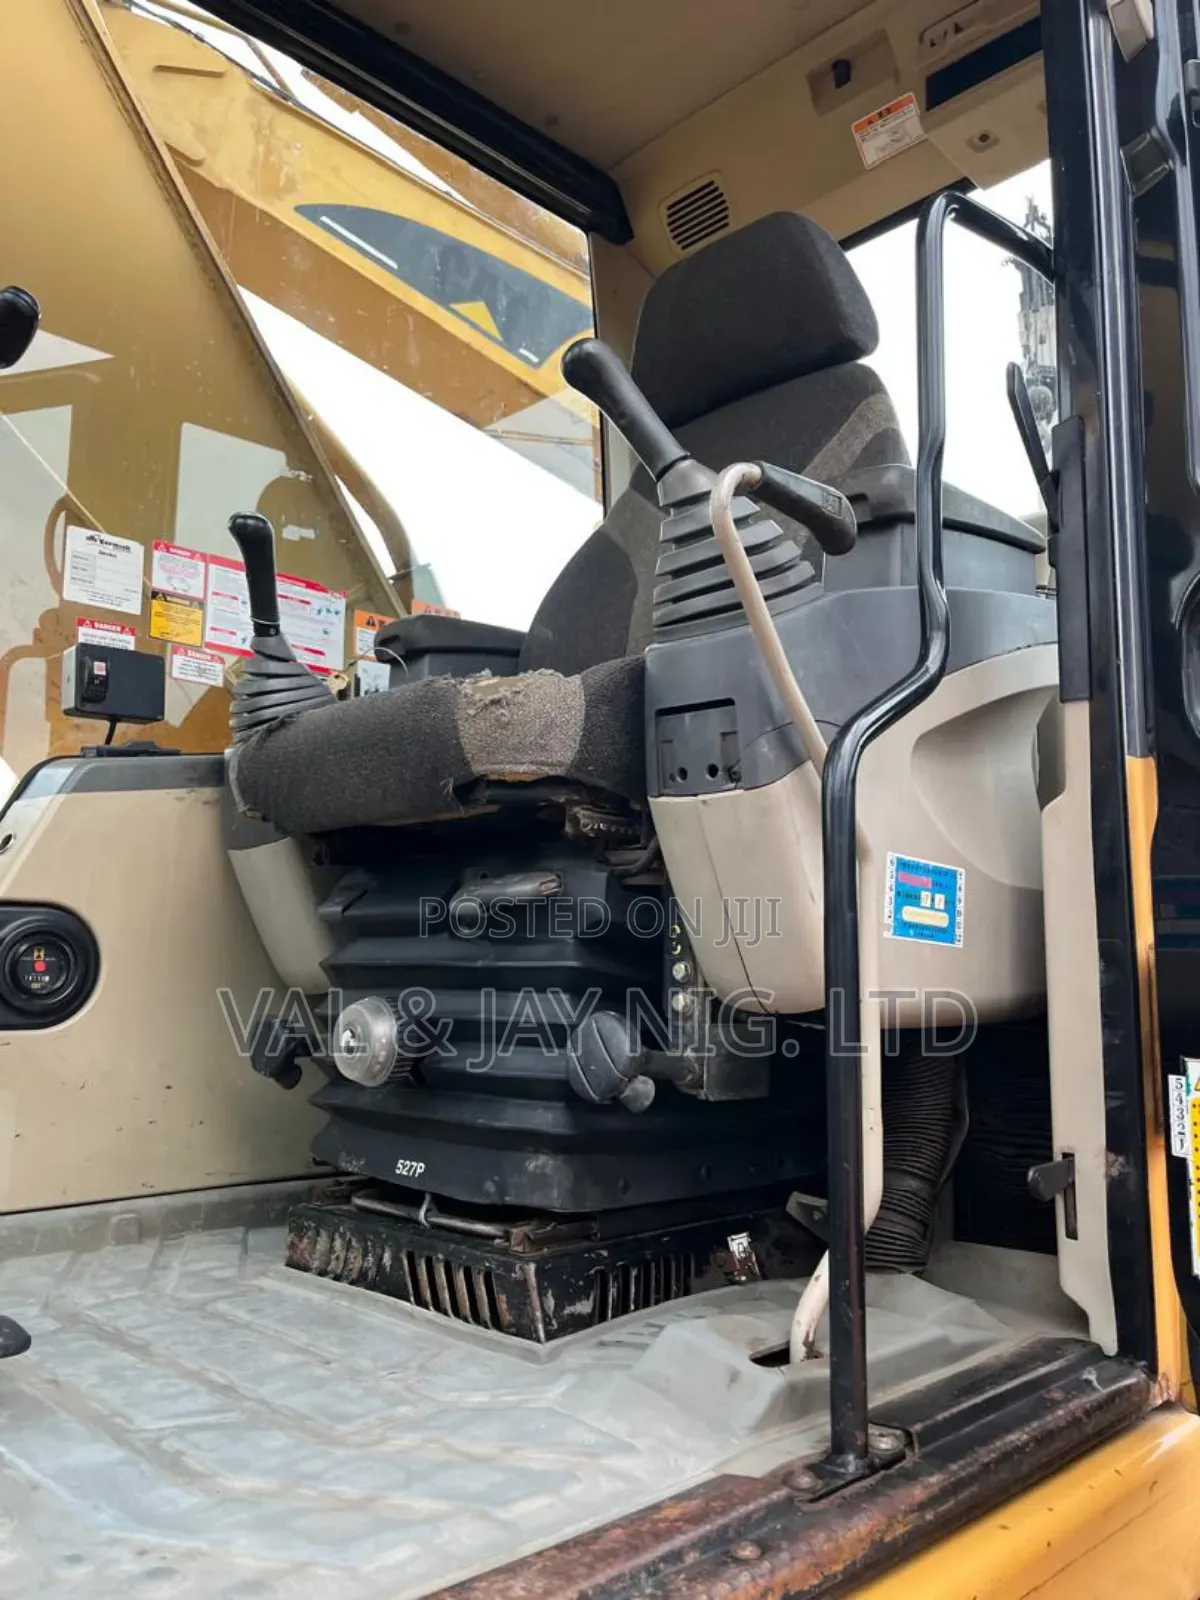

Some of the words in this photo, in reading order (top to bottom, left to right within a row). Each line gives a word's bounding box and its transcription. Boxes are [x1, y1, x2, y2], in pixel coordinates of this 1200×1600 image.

[1174, 1077, 1184, 1090] 5
[1176, 1107, 1185, 1120] 3
[394, 1158, 426, 1178] 527P
